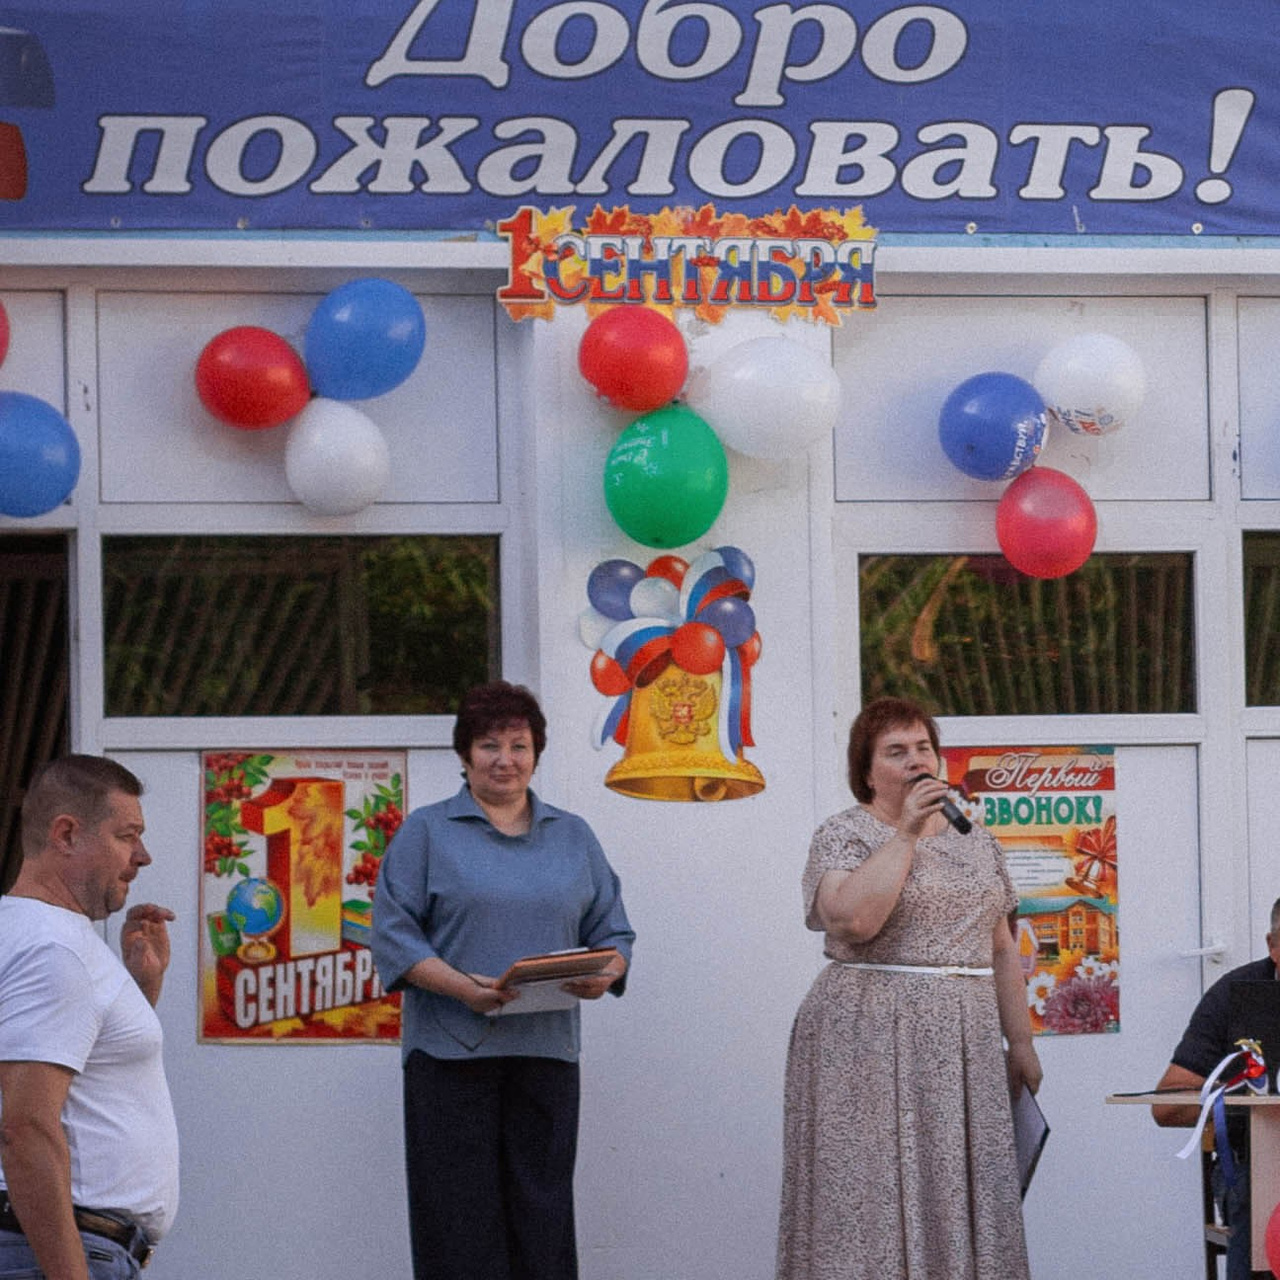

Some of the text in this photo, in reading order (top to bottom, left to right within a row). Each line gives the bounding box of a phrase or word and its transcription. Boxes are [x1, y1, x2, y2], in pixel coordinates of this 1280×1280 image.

[82, 88, 1256, 205] пожаловать!
[498, 205, 878, 308] 1 СЕНТЯБРЯ
[984, 794, 1103, 827] ЗВОНОК!
[986, 752, 1106, 797] Первый
[240, 777, 345, 959] 1
